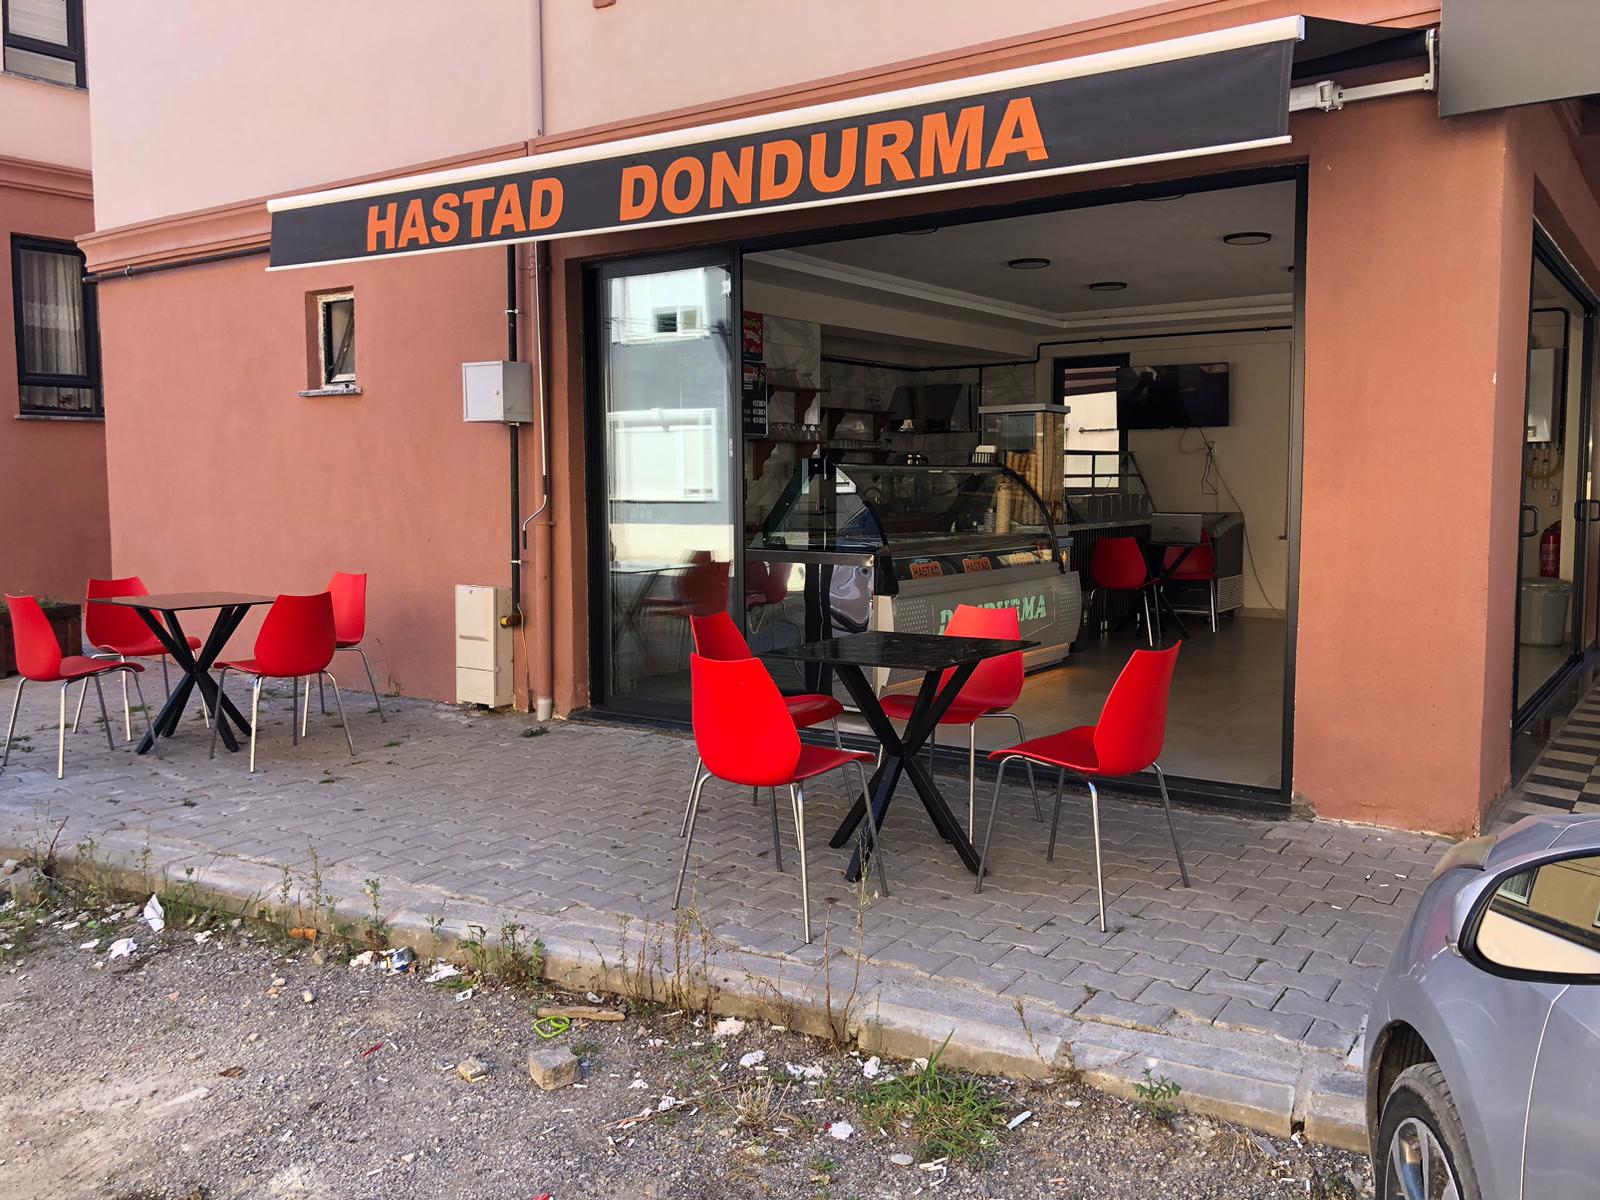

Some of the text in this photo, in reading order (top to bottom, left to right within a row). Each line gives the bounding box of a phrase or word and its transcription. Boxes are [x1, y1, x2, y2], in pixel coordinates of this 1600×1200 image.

[367, 96, 1049, 252] HASTAD DONDURMA
[938, 593, 1047, 636] DRMA
